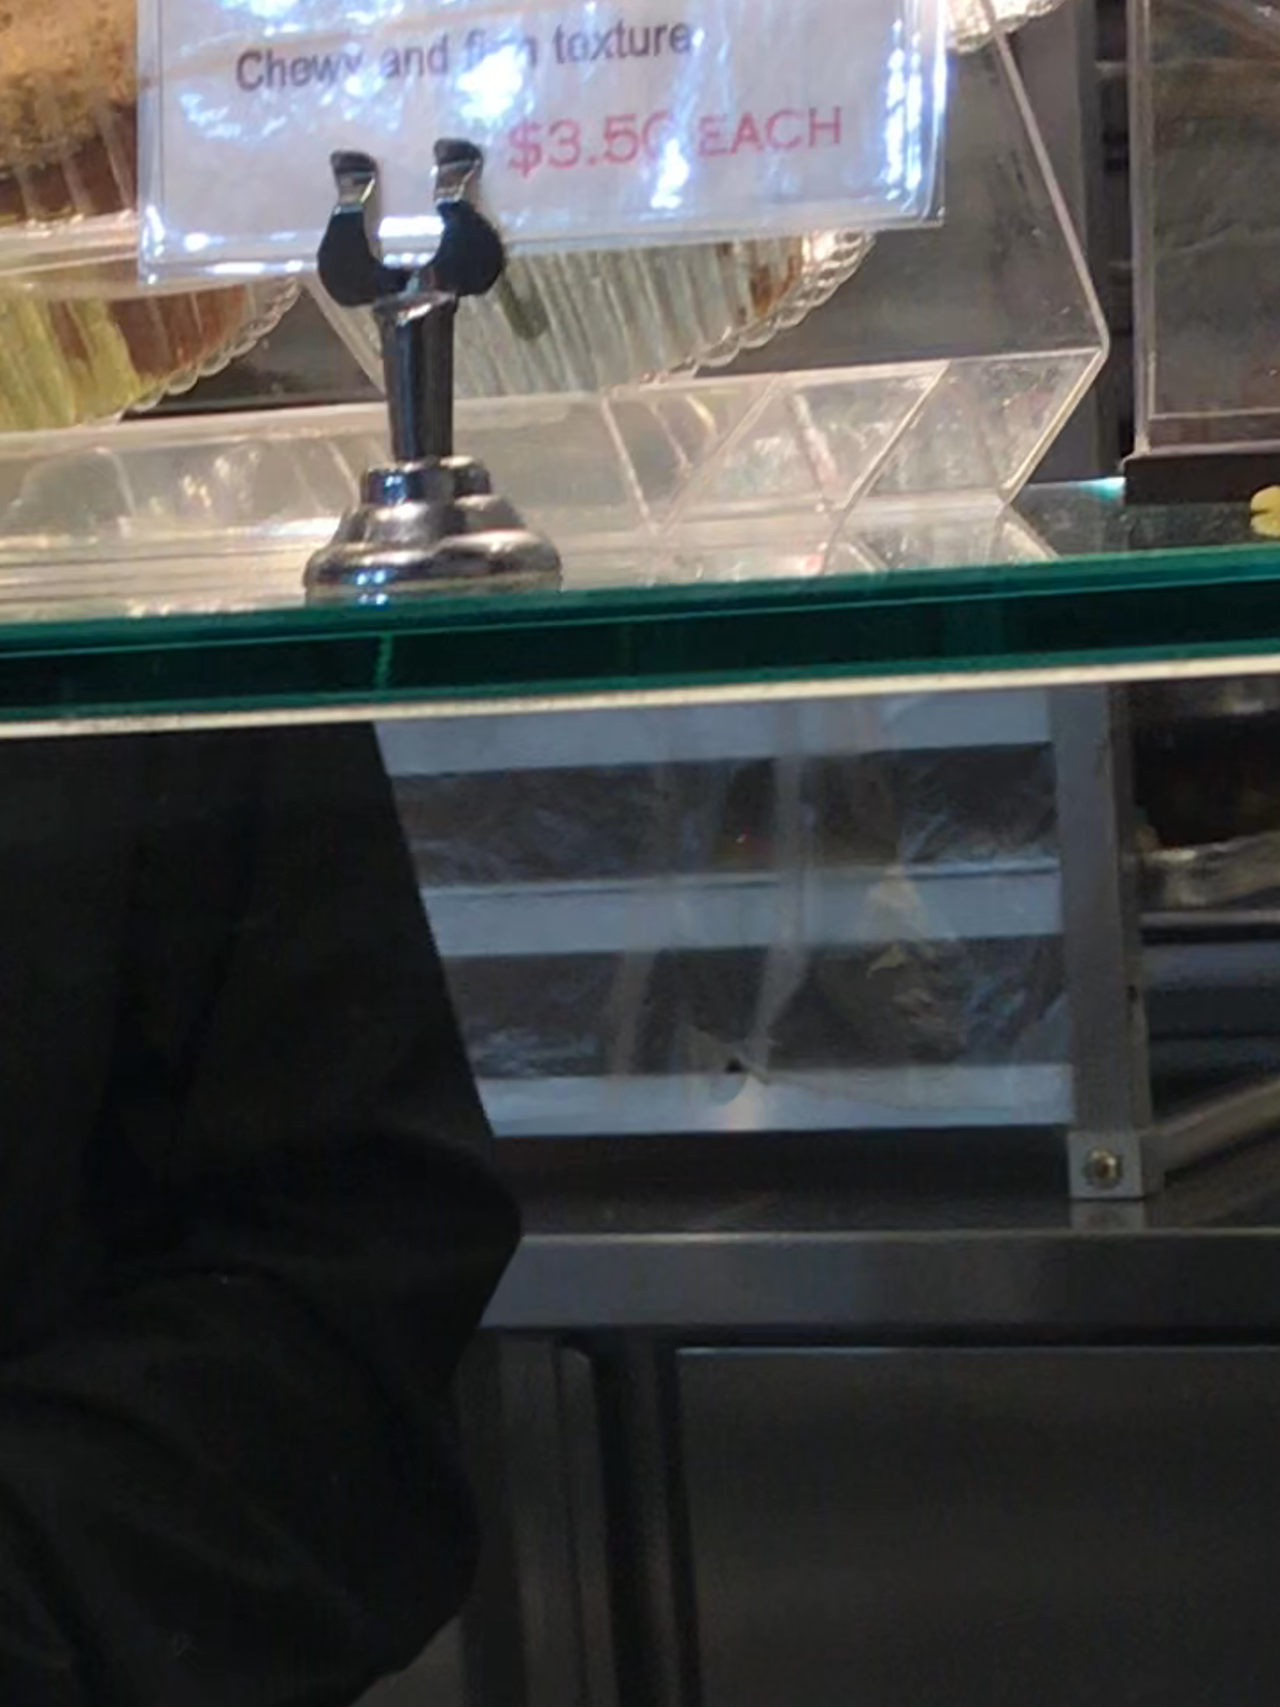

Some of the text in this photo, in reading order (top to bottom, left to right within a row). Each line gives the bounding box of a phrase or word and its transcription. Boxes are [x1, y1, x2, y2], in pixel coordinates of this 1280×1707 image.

[384, 32, 449, 78] and
[553, 22, 694, 64] texture
[697, 105, 842, 158] EACH
